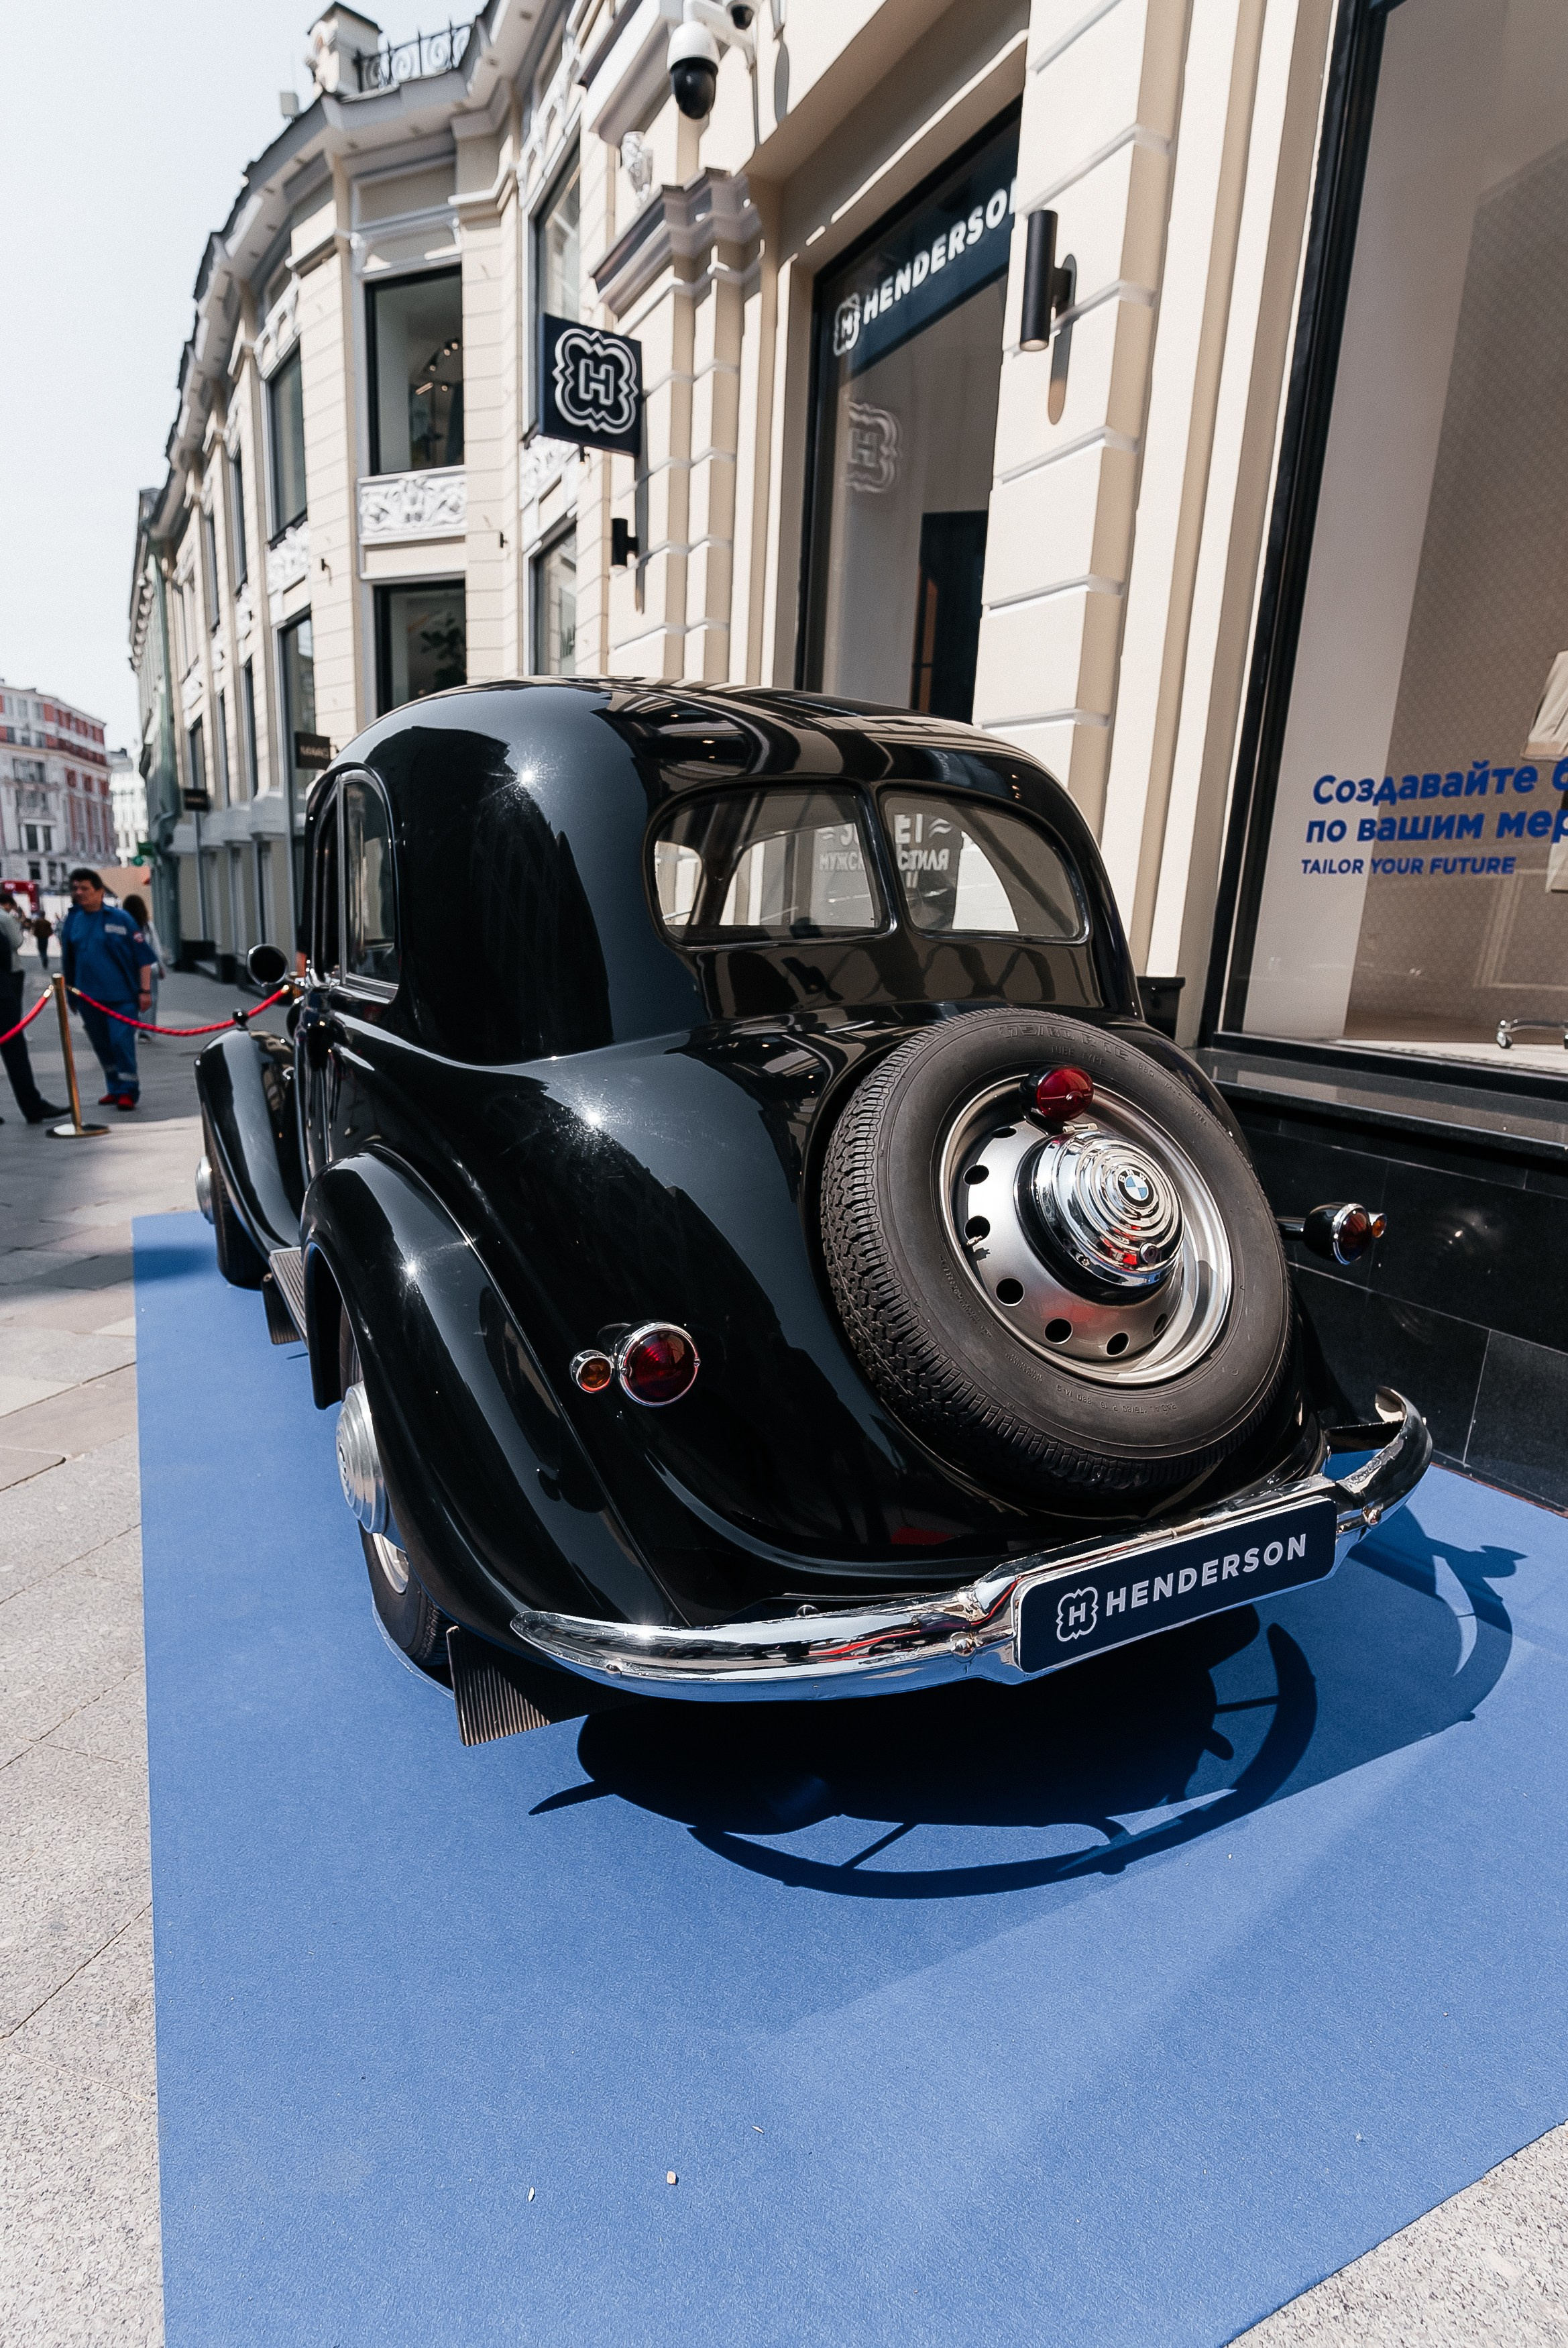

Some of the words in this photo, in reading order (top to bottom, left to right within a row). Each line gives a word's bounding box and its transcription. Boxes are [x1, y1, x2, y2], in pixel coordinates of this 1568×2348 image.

[863, 177, 1017, 325] HENDERSO
[1312, 759, 1538, 806] Создавайте
[1306, 818, 1347, 843] по
[1357, 812, 1485, 843] вашим
[1301, 858, 1364, 875] TAILOR
[1370, 857, 1424, 875] YOUR
[1430, 856, 1517, 875] FUTURE
[1118, 1169, 1147, 1183] BMW
[1106, 1534, 1306, 1617] HENDERSON
